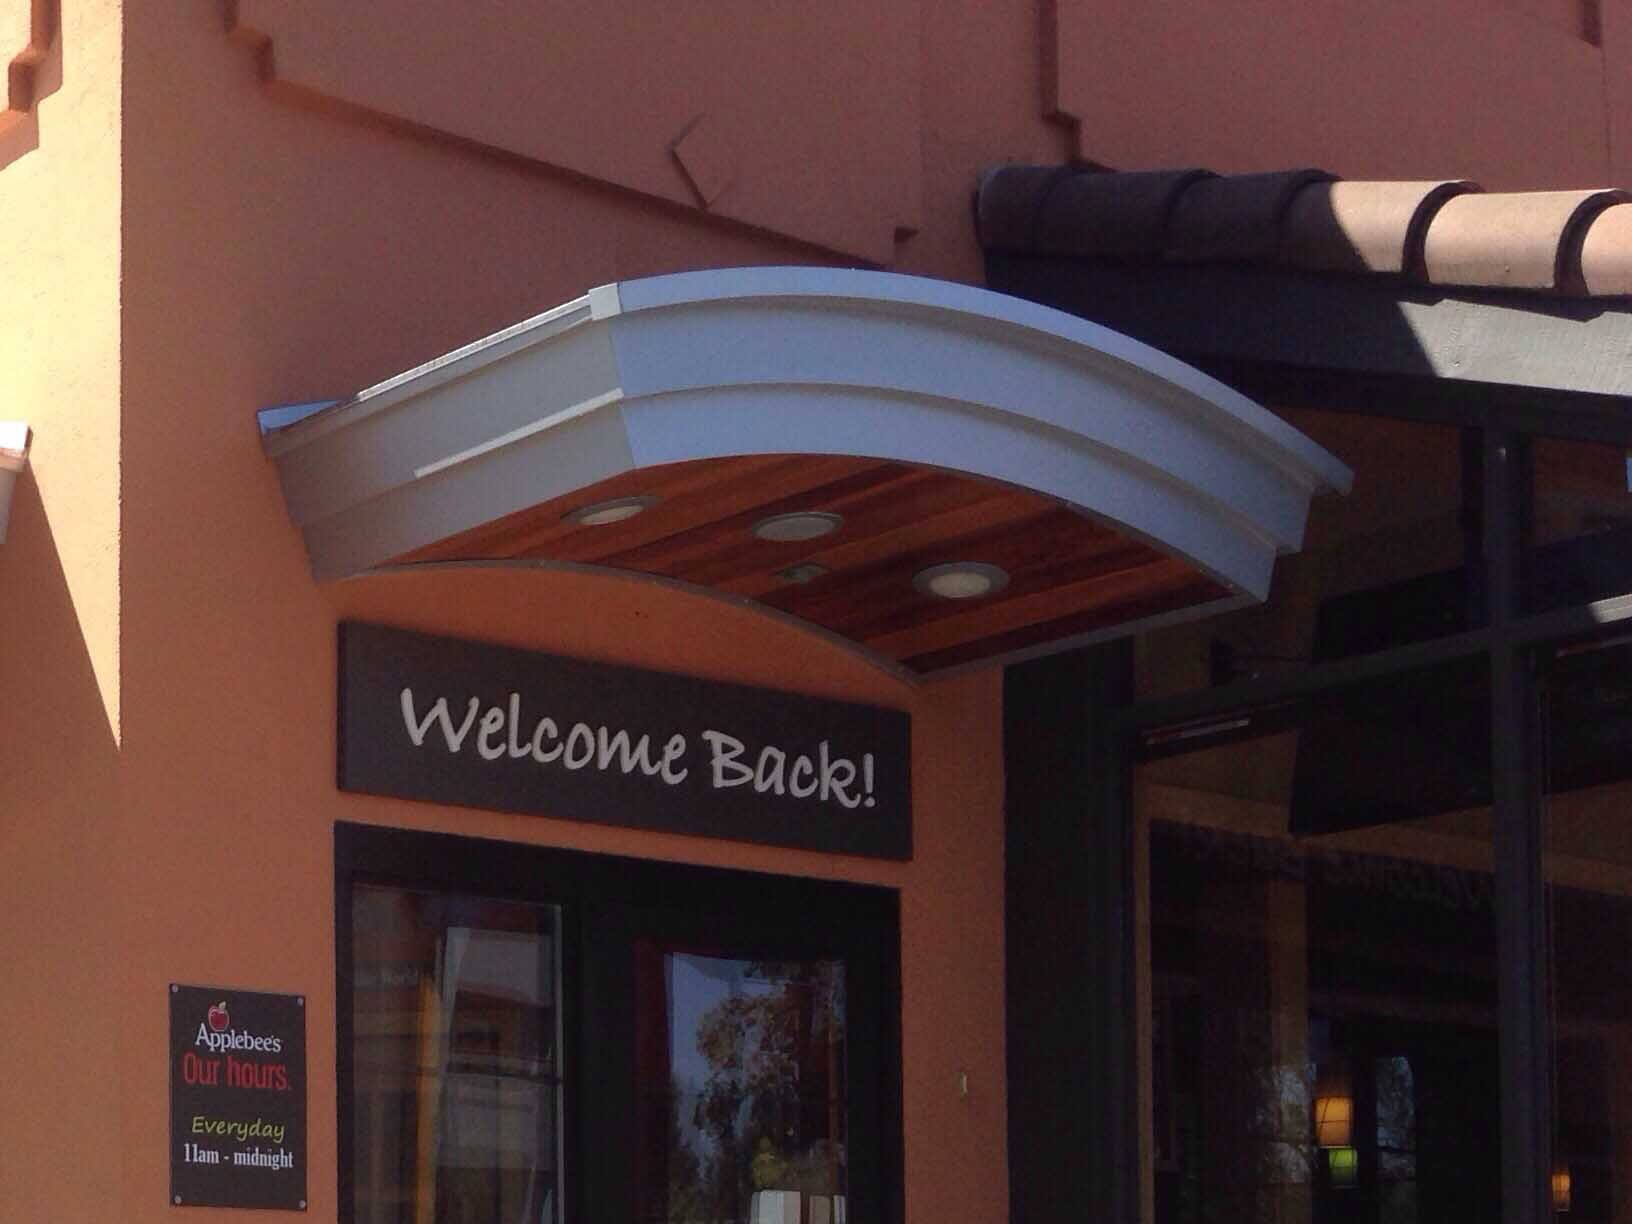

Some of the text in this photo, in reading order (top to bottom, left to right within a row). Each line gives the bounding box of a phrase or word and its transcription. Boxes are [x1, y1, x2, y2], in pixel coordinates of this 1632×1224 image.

[400, 687, 878, 809] Welcome Back!
[194, 1022, 282, 1053] Applebee's
[183, 1052, 292, 1090] Our hours.
[191, 1116, 286, 1144] Everyday
[184, 1143, 220, 1164] 11am
[233, 1146, 294, 1171] midnight
